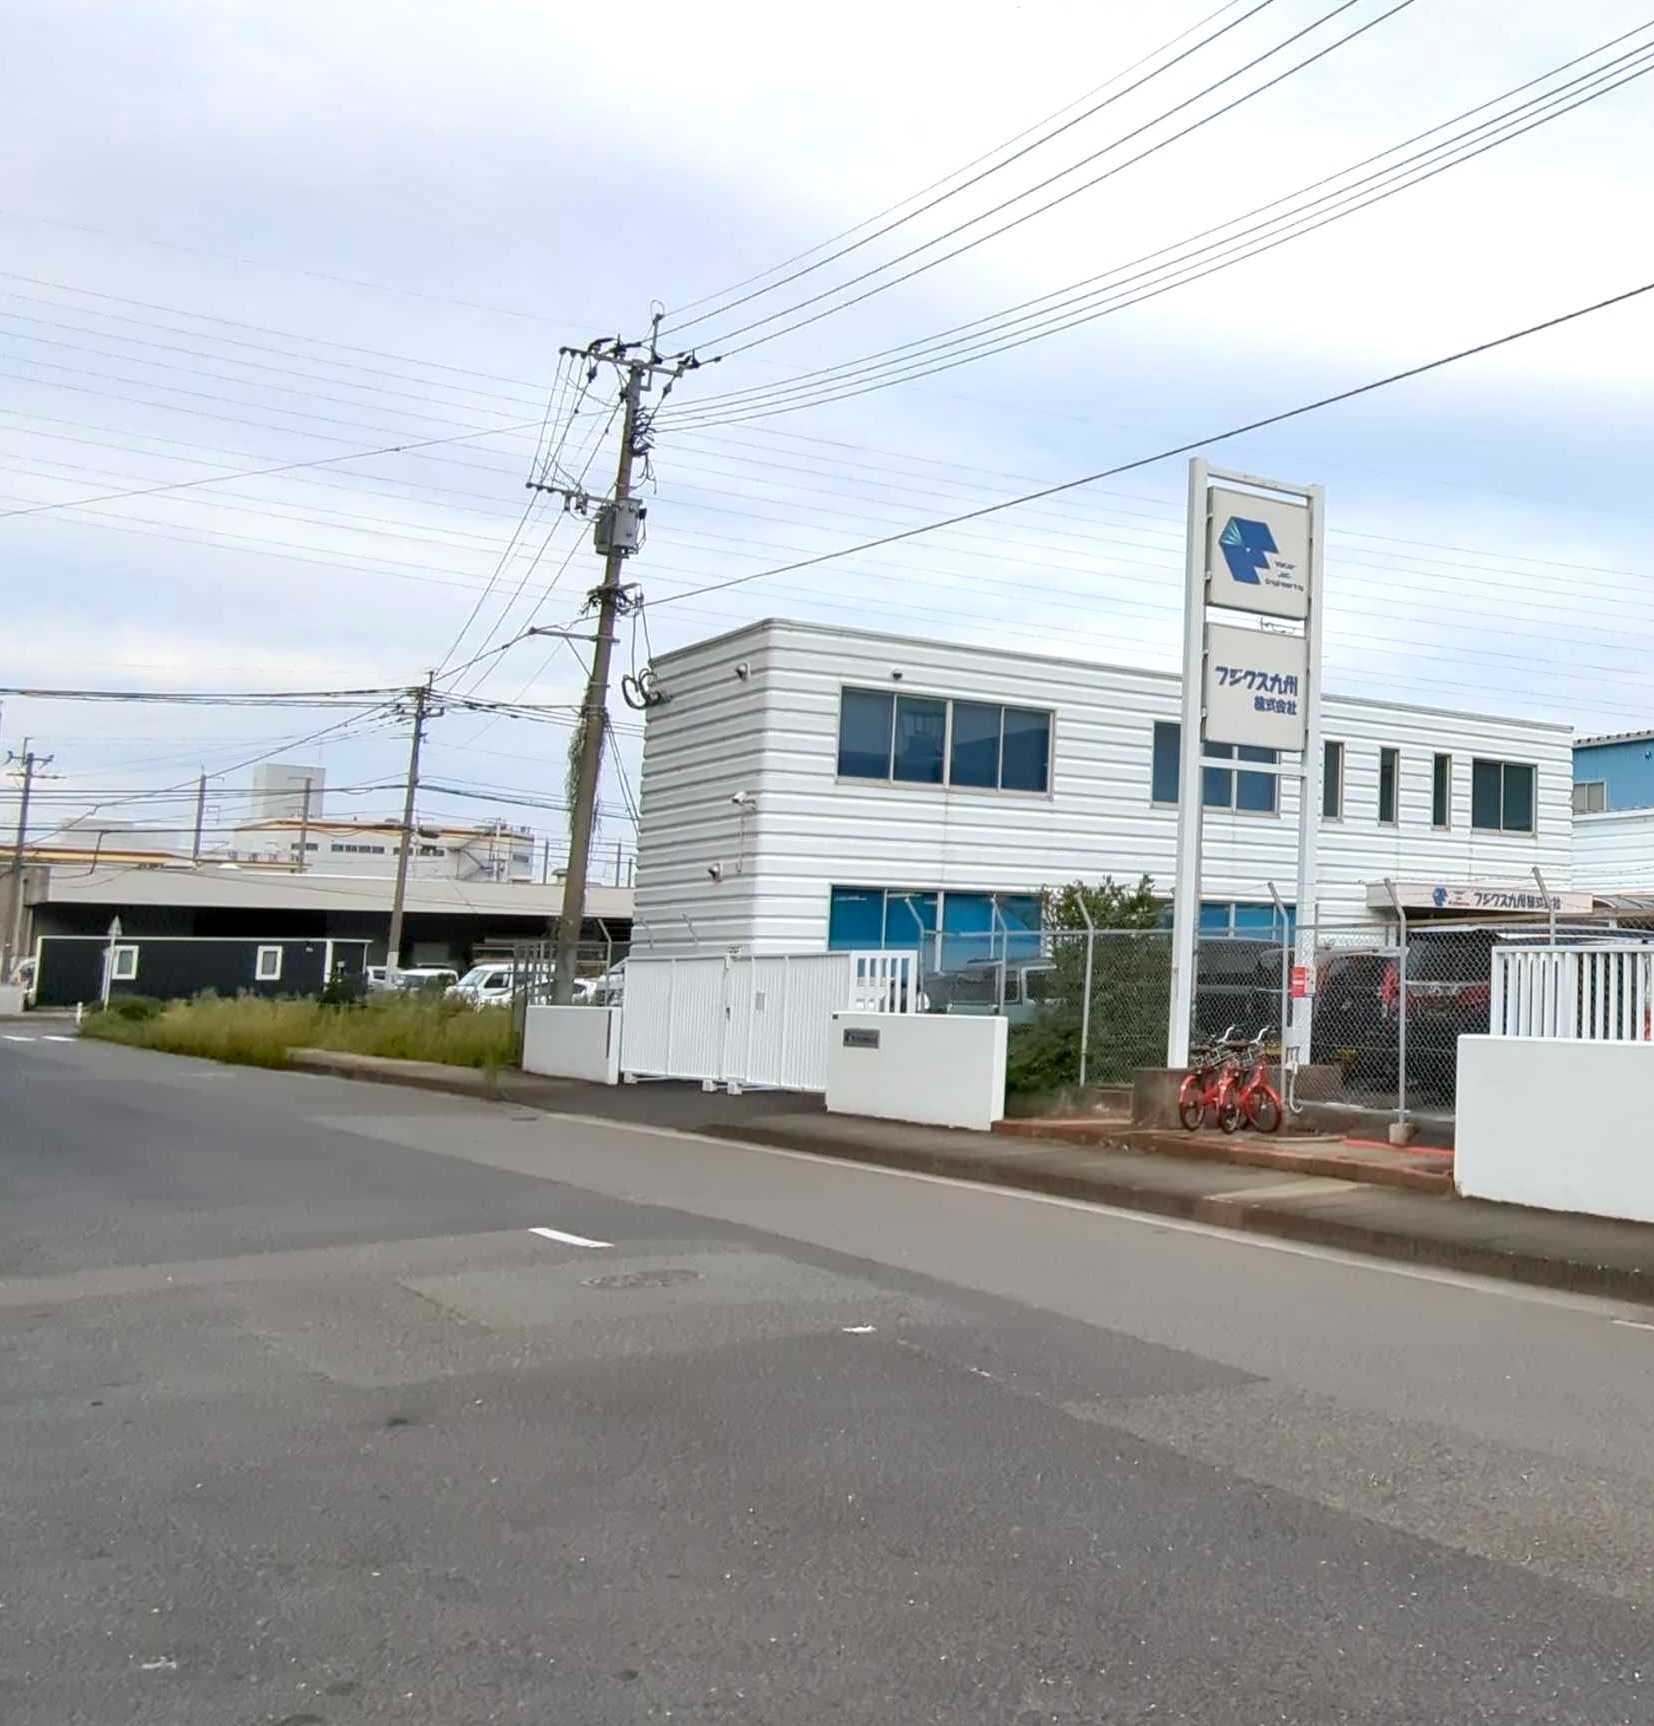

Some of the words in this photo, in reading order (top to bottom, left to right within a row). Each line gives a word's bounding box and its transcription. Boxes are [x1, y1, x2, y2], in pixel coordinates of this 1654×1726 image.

[1215, 665, 1298, 697] フジクス九州
[1254, 695, 1297, 716] 株式会社
